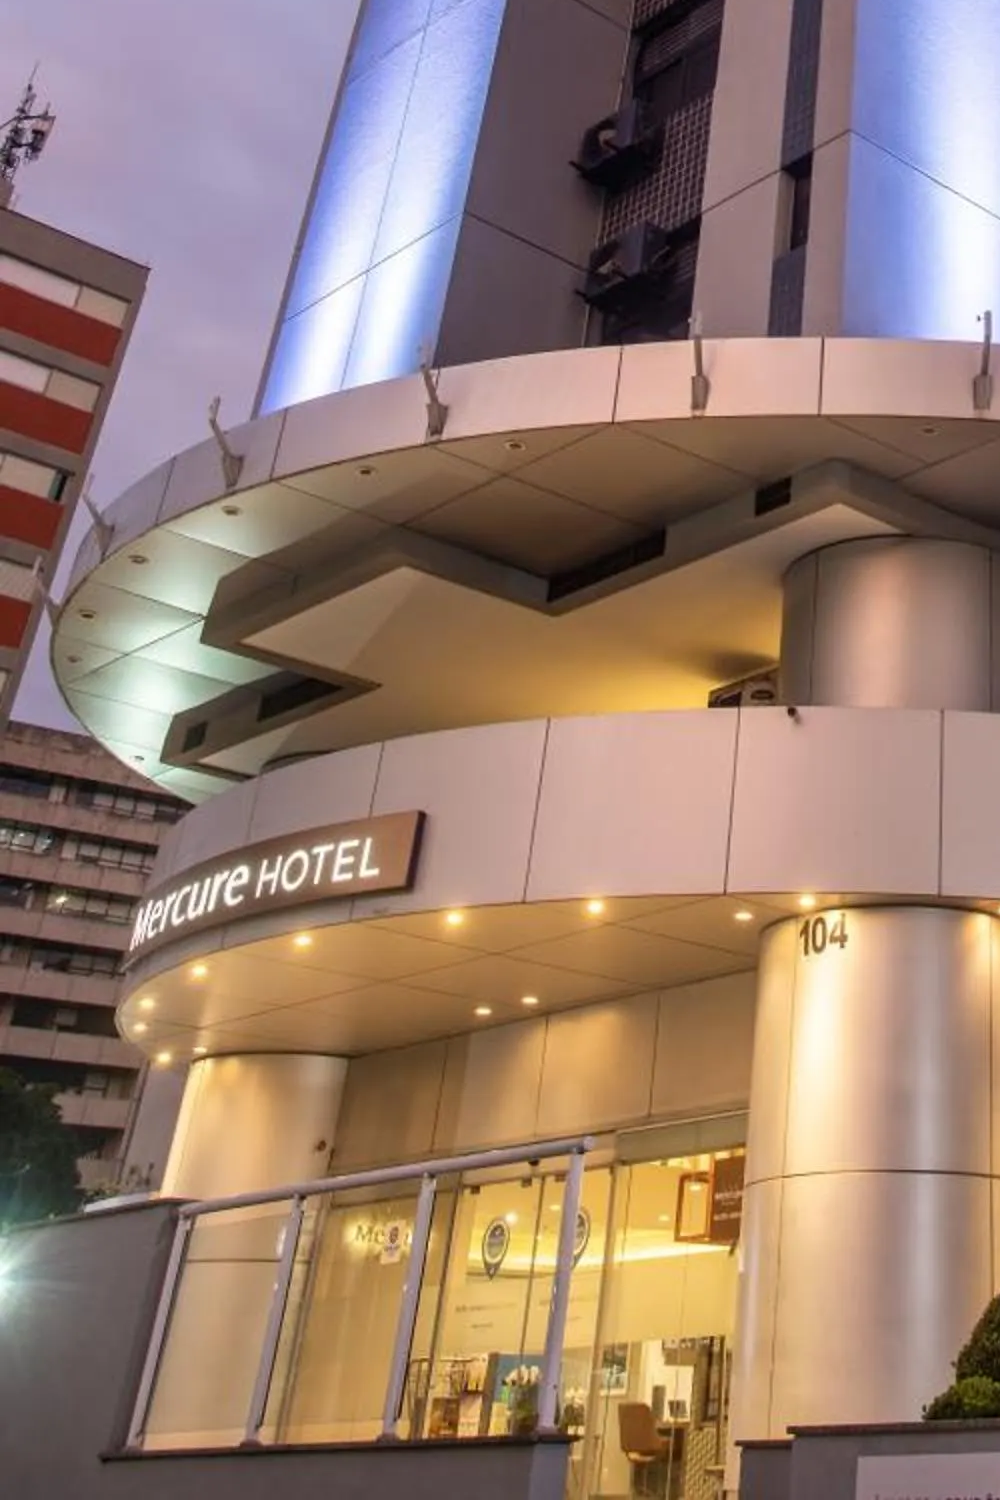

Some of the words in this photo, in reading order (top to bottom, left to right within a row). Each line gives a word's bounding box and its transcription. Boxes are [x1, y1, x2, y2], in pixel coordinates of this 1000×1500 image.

[129, 863, 250, 952] Mercure
[255, 837, 380, 899] HOTEL
[799, 912, 849, 957] 104
